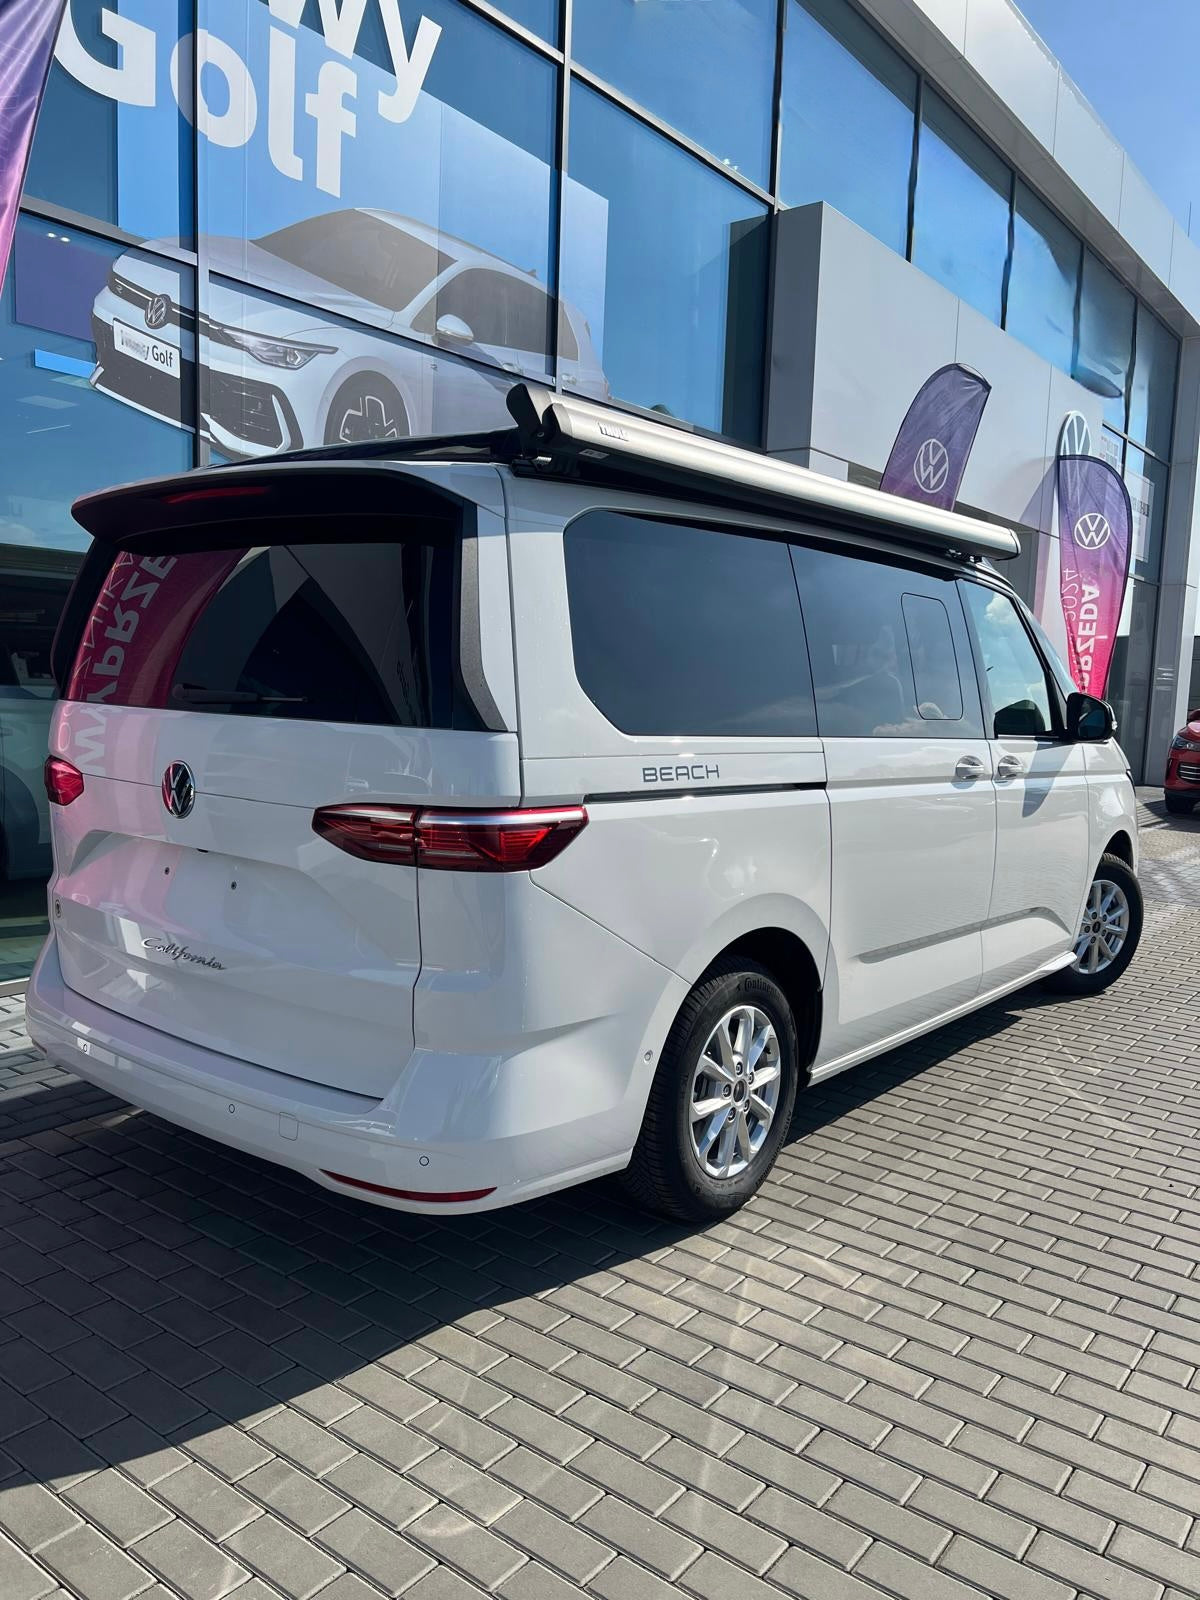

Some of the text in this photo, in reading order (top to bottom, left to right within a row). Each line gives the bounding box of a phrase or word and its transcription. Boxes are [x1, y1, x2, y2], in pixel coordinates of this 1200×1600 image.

[54, 0, 357, 199] Golf
[151, 345, 174, 368] Golf
[642, 764, 720, 783] BEACH
[141, 937, 227, 970] California
